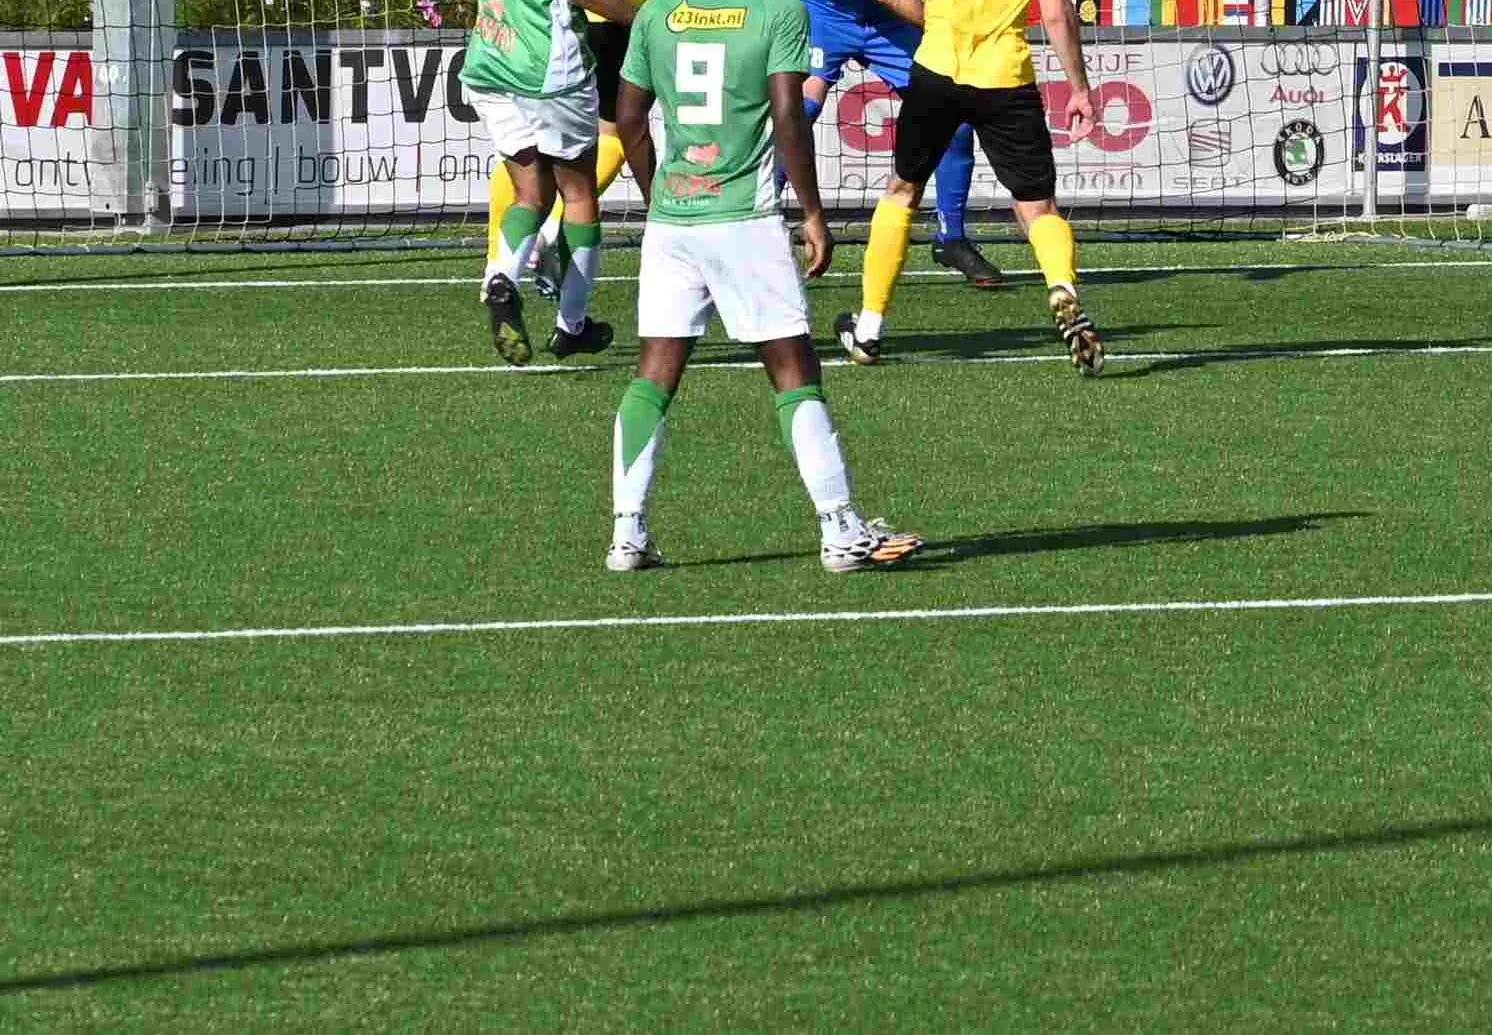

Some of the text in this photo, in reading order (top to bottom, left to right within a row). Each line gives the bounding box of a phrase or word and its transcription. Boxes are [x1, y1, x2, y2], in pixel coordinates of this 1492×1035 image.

[671, 10, 743, 27] 123inkt.nl
[171, 49, 482, 127] SANTVO
[675, 42, 726, 124] 9
